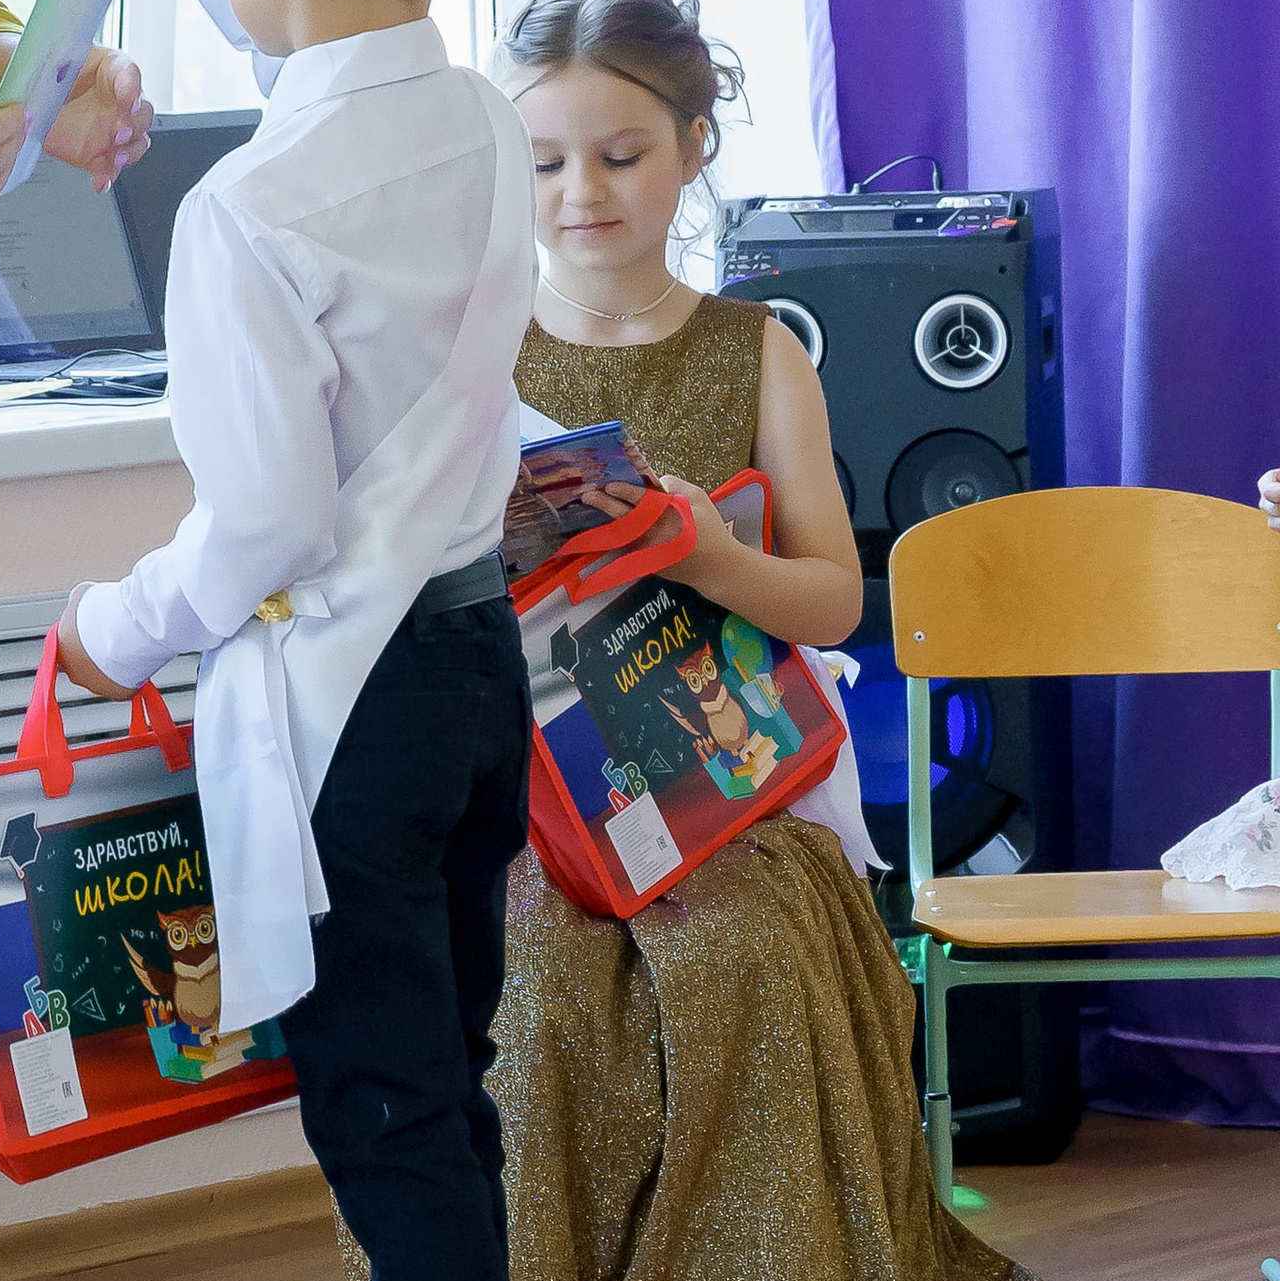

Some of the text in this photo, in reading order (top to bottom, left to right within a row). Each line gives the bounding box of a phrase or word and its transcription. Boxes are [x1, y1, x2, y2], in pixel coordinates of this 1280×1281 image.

[602, 588, 677, 656] ЗДРАВСТВУЙ,
[614, 605, 697, 694] ШКОЛА!
[73, 822, 189, 872] ЗДРАВСТВУЙ,
[75, 850, 203, 916] ШКОЛА!
